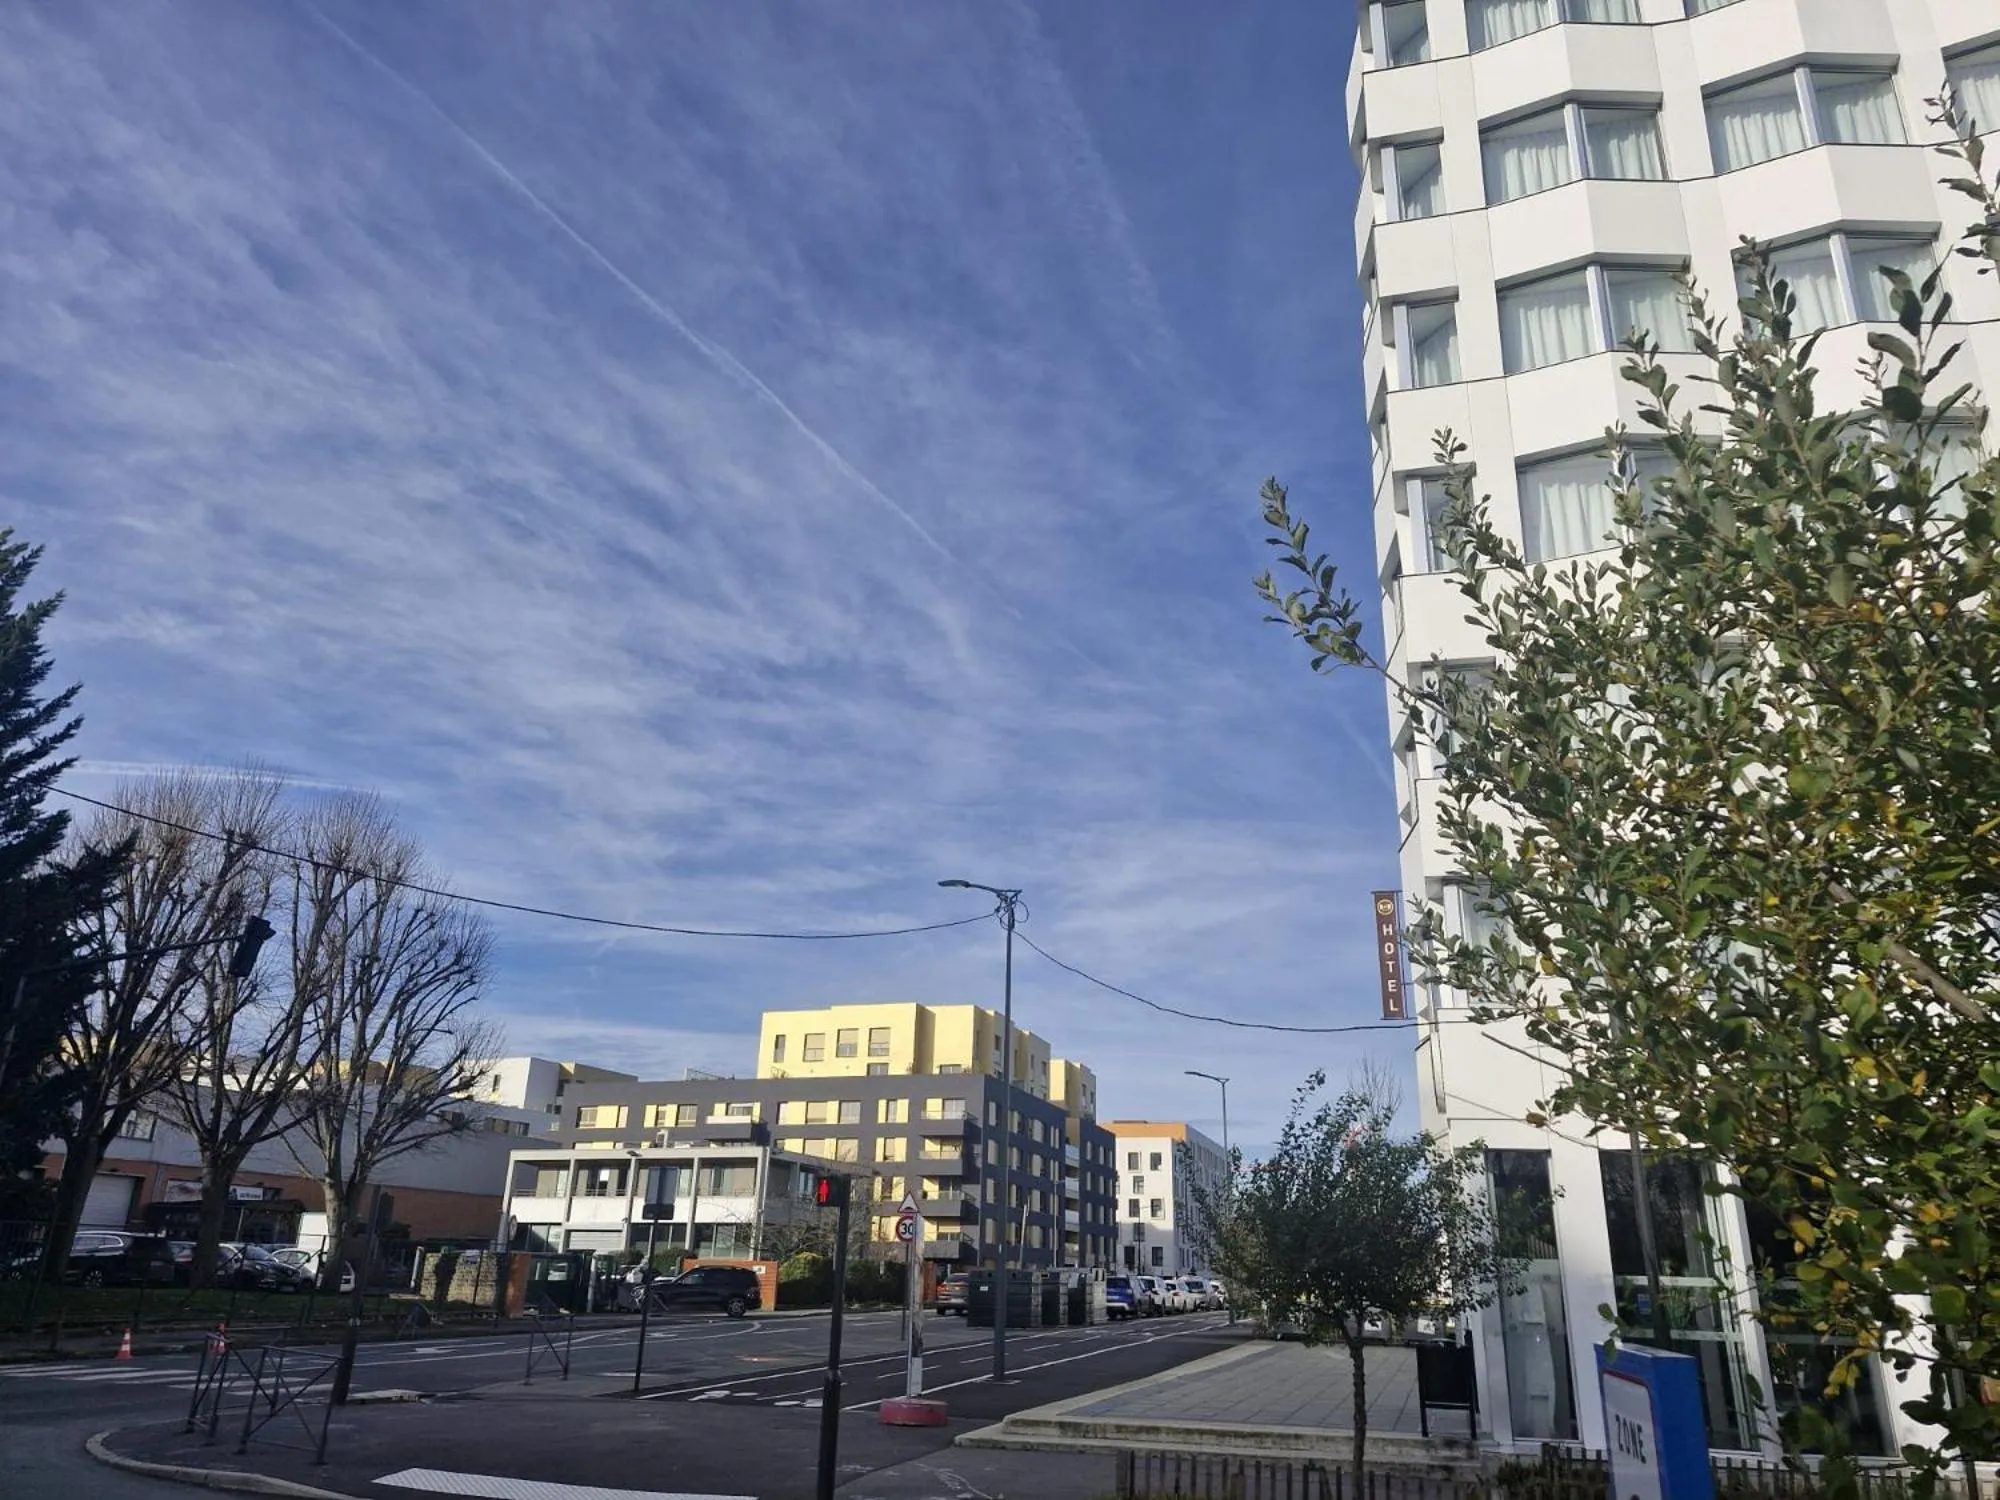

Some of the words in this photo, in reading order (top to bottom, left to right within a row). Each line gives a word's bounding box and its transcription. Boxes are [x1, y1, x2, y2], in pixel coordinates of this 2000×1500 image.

[1382, 923, 1399, 1012] HOTEL
[901, 1223, 913, 1235] 30
[1615, 1413, 1647, 1465] ZONE
